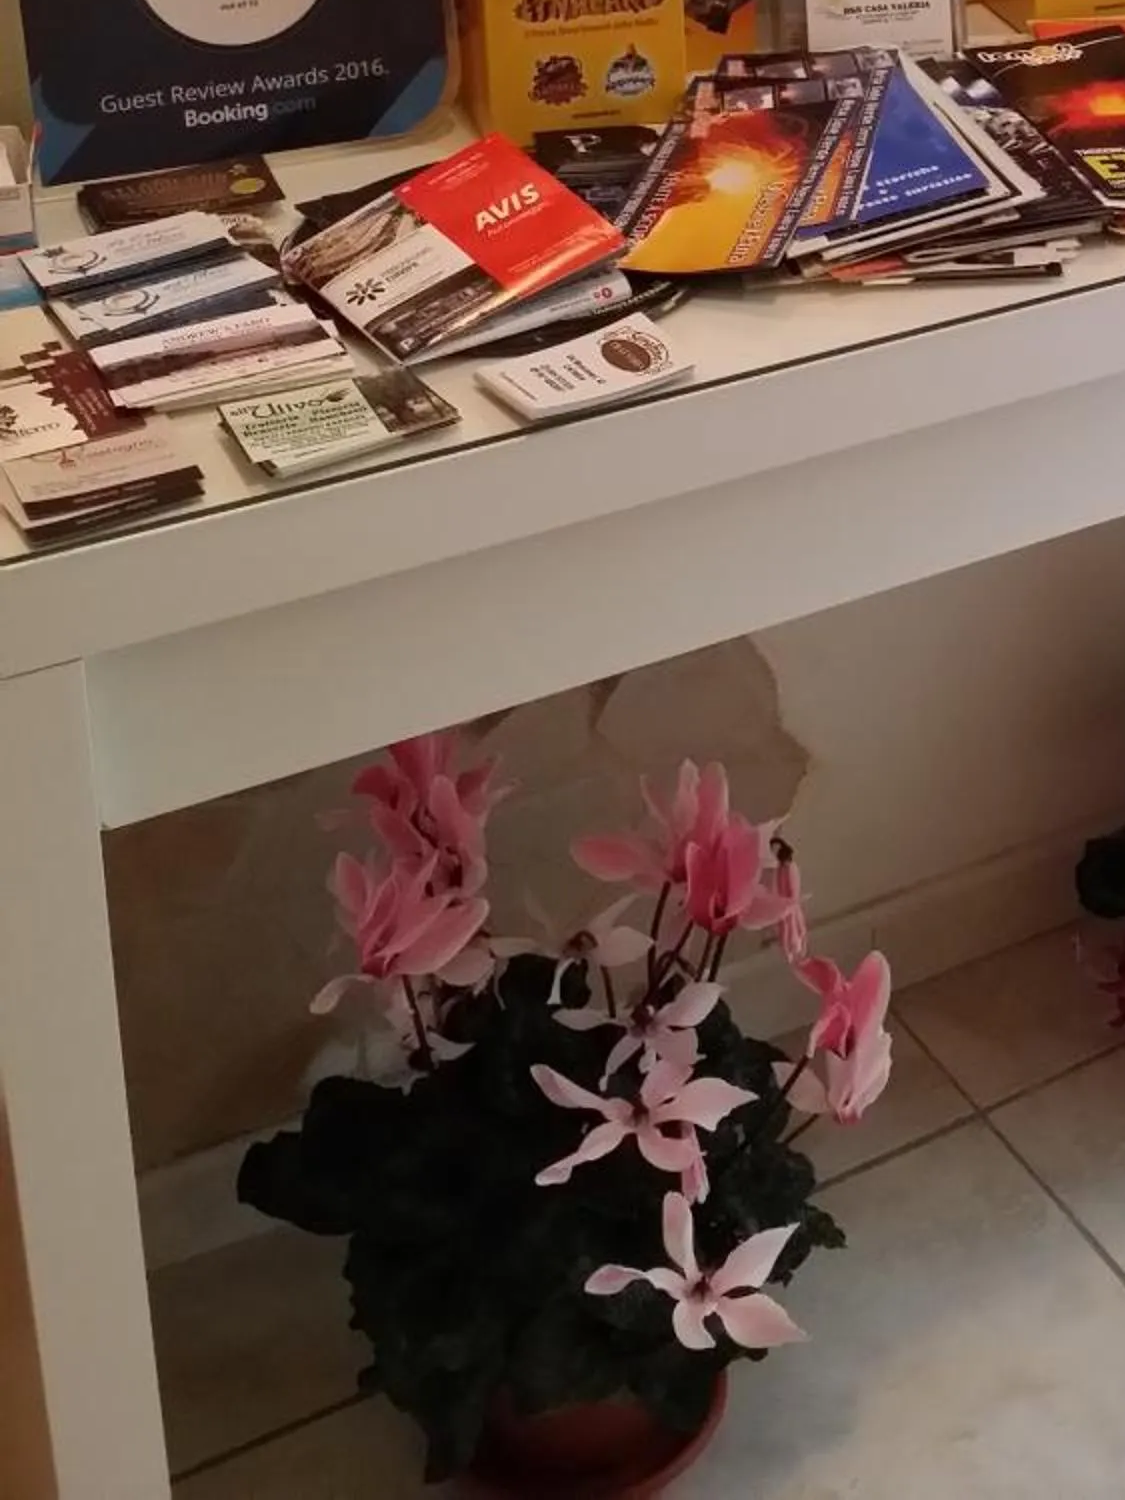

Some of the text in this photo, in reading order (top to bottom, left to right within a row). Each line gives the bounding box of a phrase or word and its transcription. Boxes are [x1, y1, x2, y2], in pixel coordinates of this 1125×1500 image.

[101, 59, 390, 115] Guest Review Awards 2016.
[475, 182, 541, 232] AVIS
